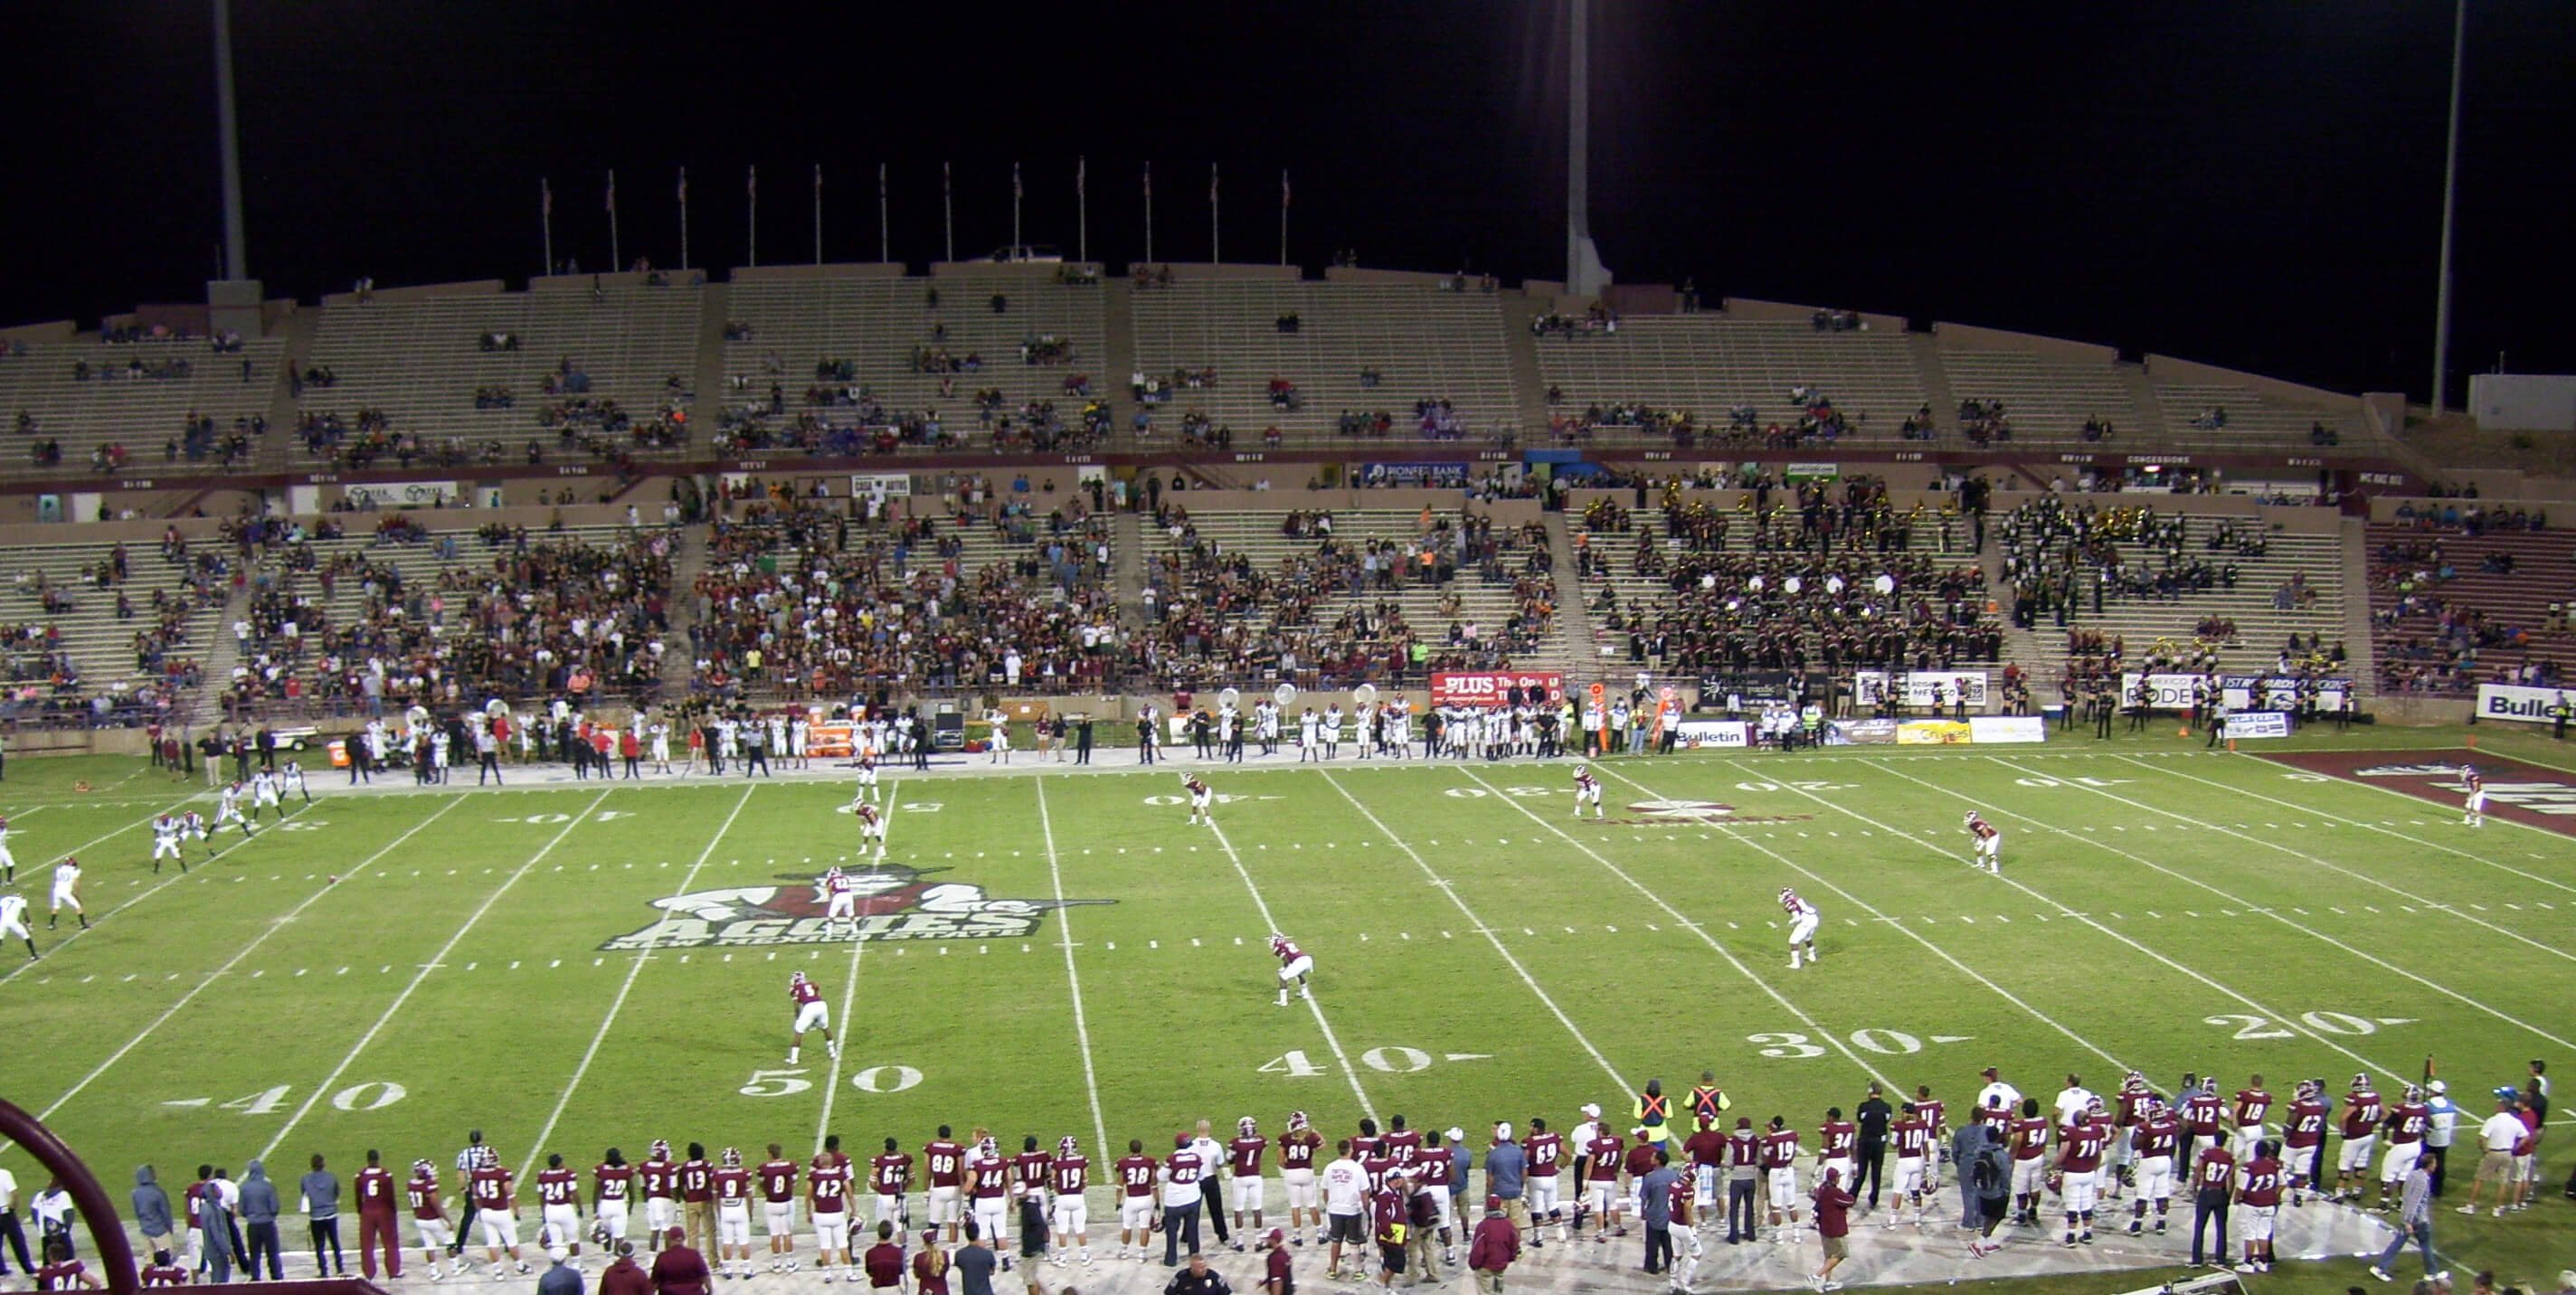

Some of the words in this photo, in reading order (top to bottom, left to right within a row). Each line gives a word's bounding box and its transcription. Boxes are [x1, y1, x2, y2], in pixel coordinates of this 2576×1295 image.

[1444, 676, 1495, 694] PLUS
[625, 912, 1037, 941] AGGIES
[608, 937, 703, 950] NEW
[715, 933, 870, 946] MEXICO
[888, 928, 1028, 941] STATE
[2197, 1106, 2215, 1123] 12
[1832, 1132, 1853, 1149] 34
[1904, 1129, 1923, 1149] 10
[1246, 1148, 1255, 1167] 1
[1288, 1144, 1310, 1160] 89
[1536, 1143, 1558, 1165] 69
[1742, 1144, 1749, 1163] 1
[1777, 1140, 1795, 1160] 19
[931, 1154, 955, 1174] 88
[2204, 1161, 2230, 1182] 87
[649, 1174, 661, 1191] 2
[687, 1171, 706, 1190] 13
[773, 1175, 786, 1194] 8
[980, 1169, 1004, 1188] 44
[1060, 1167, 1082, 1189] 19
[1126, 1167, 1150, 1186] 38
[366, 1178, 379, 1197] 6
[477, 1178, 499, 1199] 45
[544, 1181, 566, 1201] 24
[724, 1179, 738, 1197] 9
[816, 1179, 843, 1197] 42
